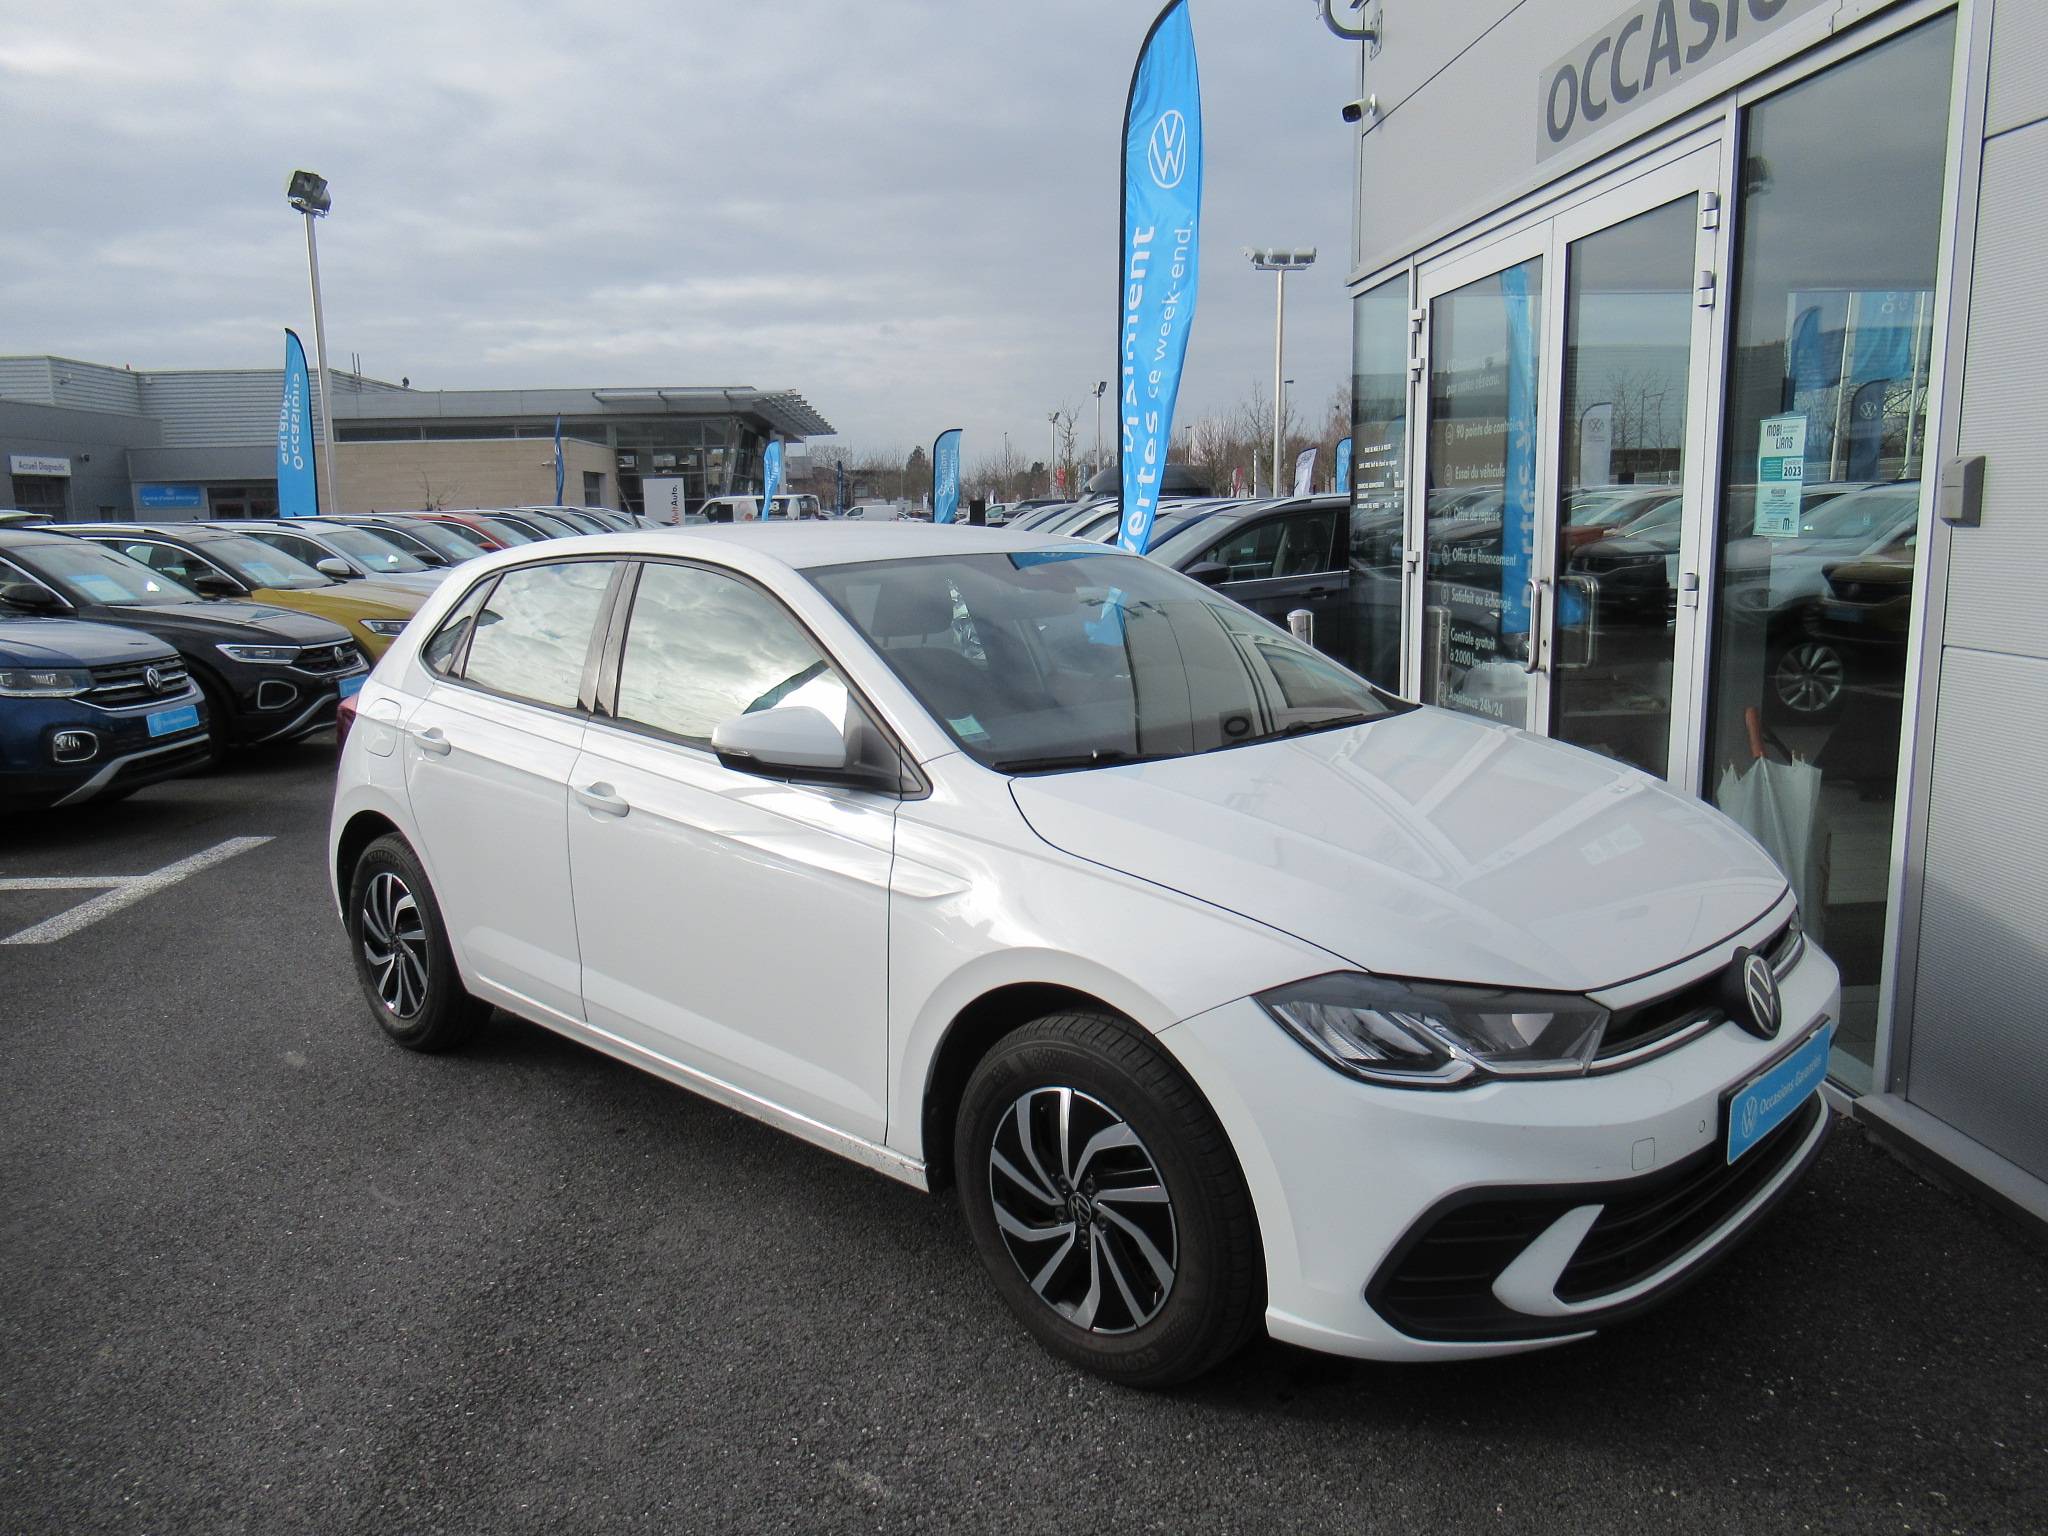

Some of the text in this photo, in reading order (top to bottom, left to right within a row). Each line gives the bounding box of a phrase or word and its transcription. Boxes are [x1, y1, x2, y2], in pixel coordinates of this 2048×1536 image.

[1148, 369, 1162, 399] ce
[1783, 466, 1802, 477] 2023
[1452, 547, 1468, 563] Offre
[1468, 547, 1477, 563] de
[1450, 627, 1474, 646] Contrôle
